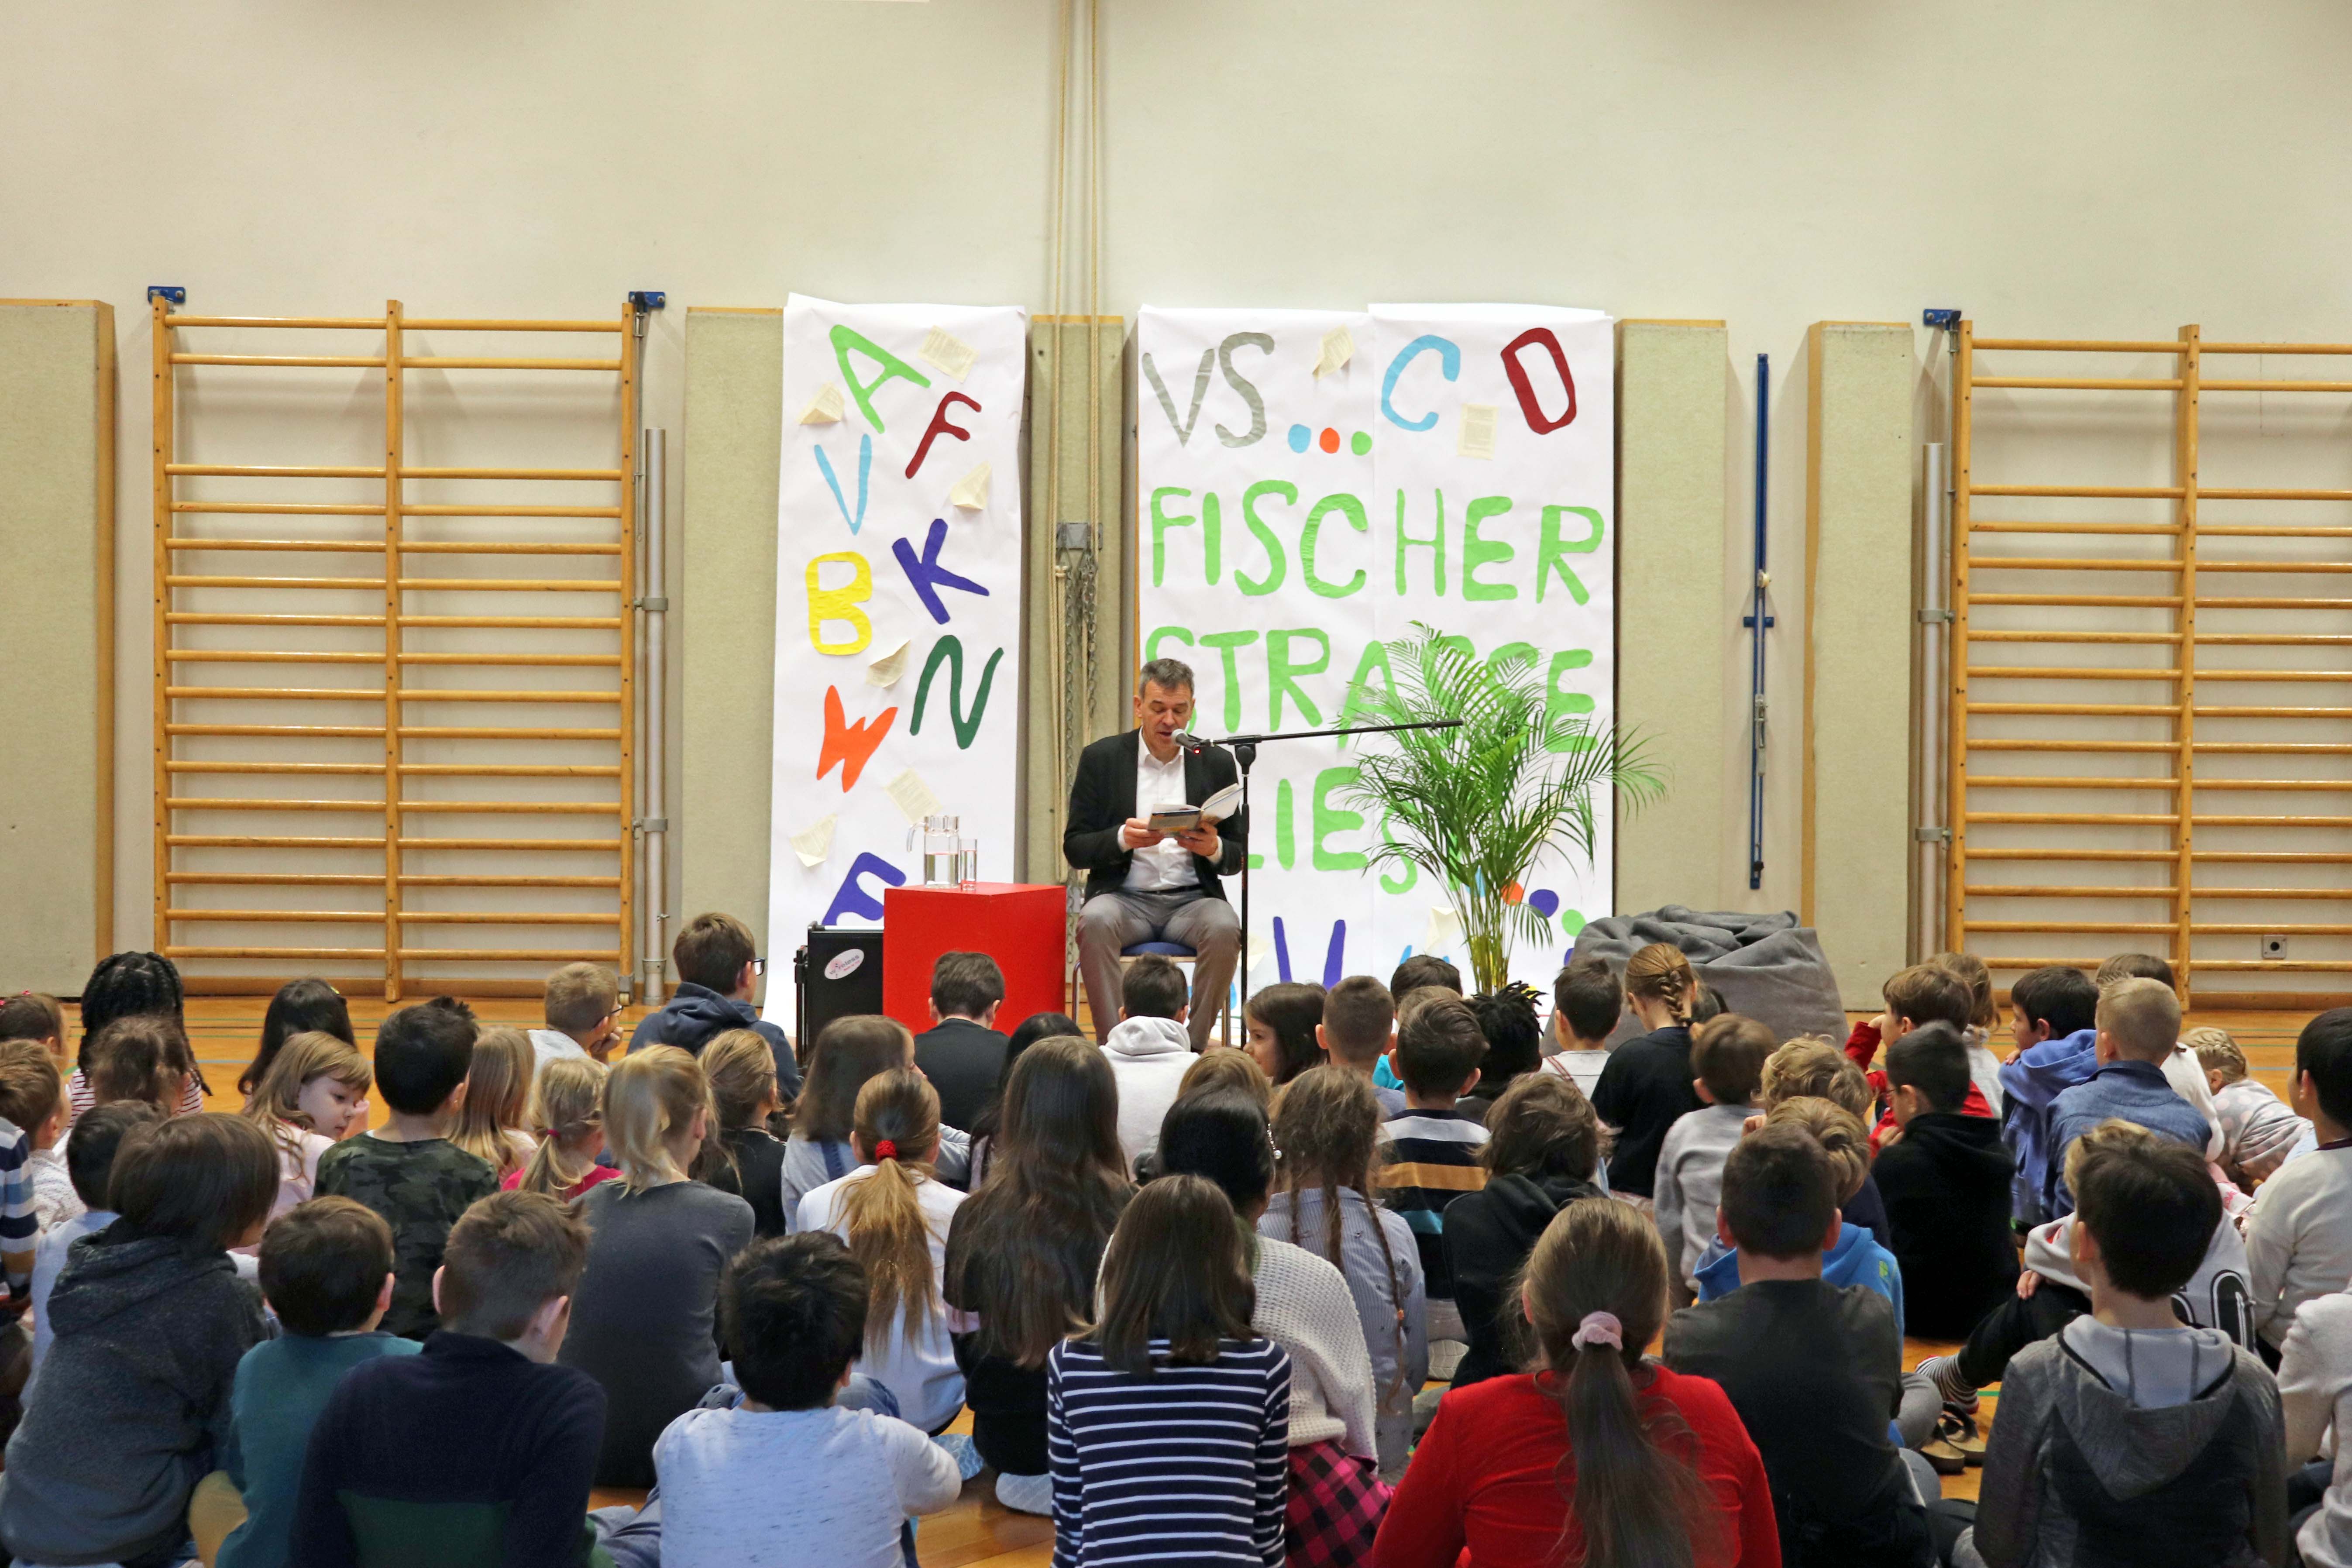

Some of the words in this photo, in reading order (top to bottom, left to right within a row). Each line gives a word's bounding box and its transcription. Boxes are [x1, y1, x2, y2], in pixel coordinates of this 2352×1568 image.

[829, 324, 931, 433] A
[1381, 334, 1460, 431] C
[814, 433, 872, 535] V
[905, 391, 982, 479] F
[892, 518, 990, 624] K
[1151, 480, 1604, 605] FISCHER
[805, 551, 872, 655] B
[817, 685, 898, 793] W
[910, 635, 1004, 750] N
